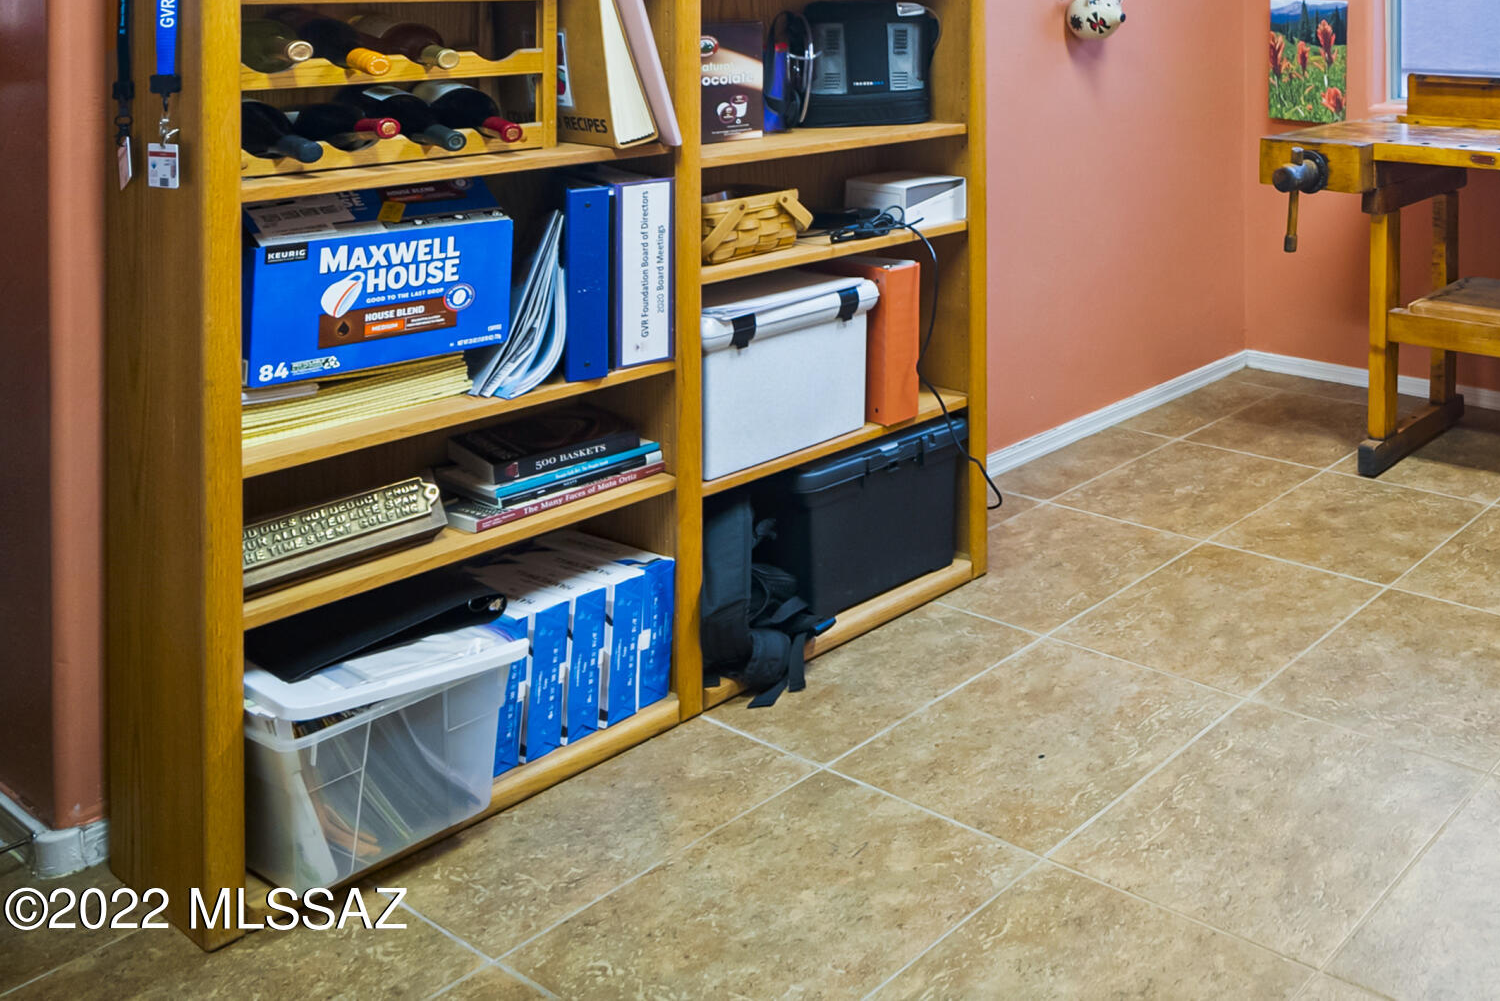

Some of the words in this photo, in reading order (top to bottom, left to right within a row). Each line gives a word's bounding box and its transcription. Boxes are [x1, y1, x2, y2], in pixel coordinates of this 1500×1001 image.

[701, 61, 736, 72] atural
[701, 73, 753, 87] ocolate
[565, 115, 608, 134] RECIPES
[640, 190, 649, 230] Directors
[640, 231, 649, 240] of
[656, 225, 666, 265] Meetings
[267, 249, 307, 261] KEURIG
[319, 236, 461, 274] MAXWELL
[641, 241, 649, 268] Board
[366, 259, 460, 293] HOUSE
[656, 267, 664, 292] Board
[366, 296, 386, 304] GOOD
[398, 292, 410, 300] THE
[411, 290, 426, 298] LAST
[641, 269, 649, 319] Foundation
[657, 294, 665, 314] 2020
[365, 311, 395, 322] HOUSE
[397, 305, 425, 317] BLEND
[641, 320, 650, 338] GVR
[258, 361, 289, 383] 84
[535, 456, 557, 471] 500
[559, 444, 607, 462] BASKETS
[524, 503, 539, 515] The
[540, 496, 564, 512] Many
[565, 490, 586, 502] Faces
[587, 485, 597, 494] of
